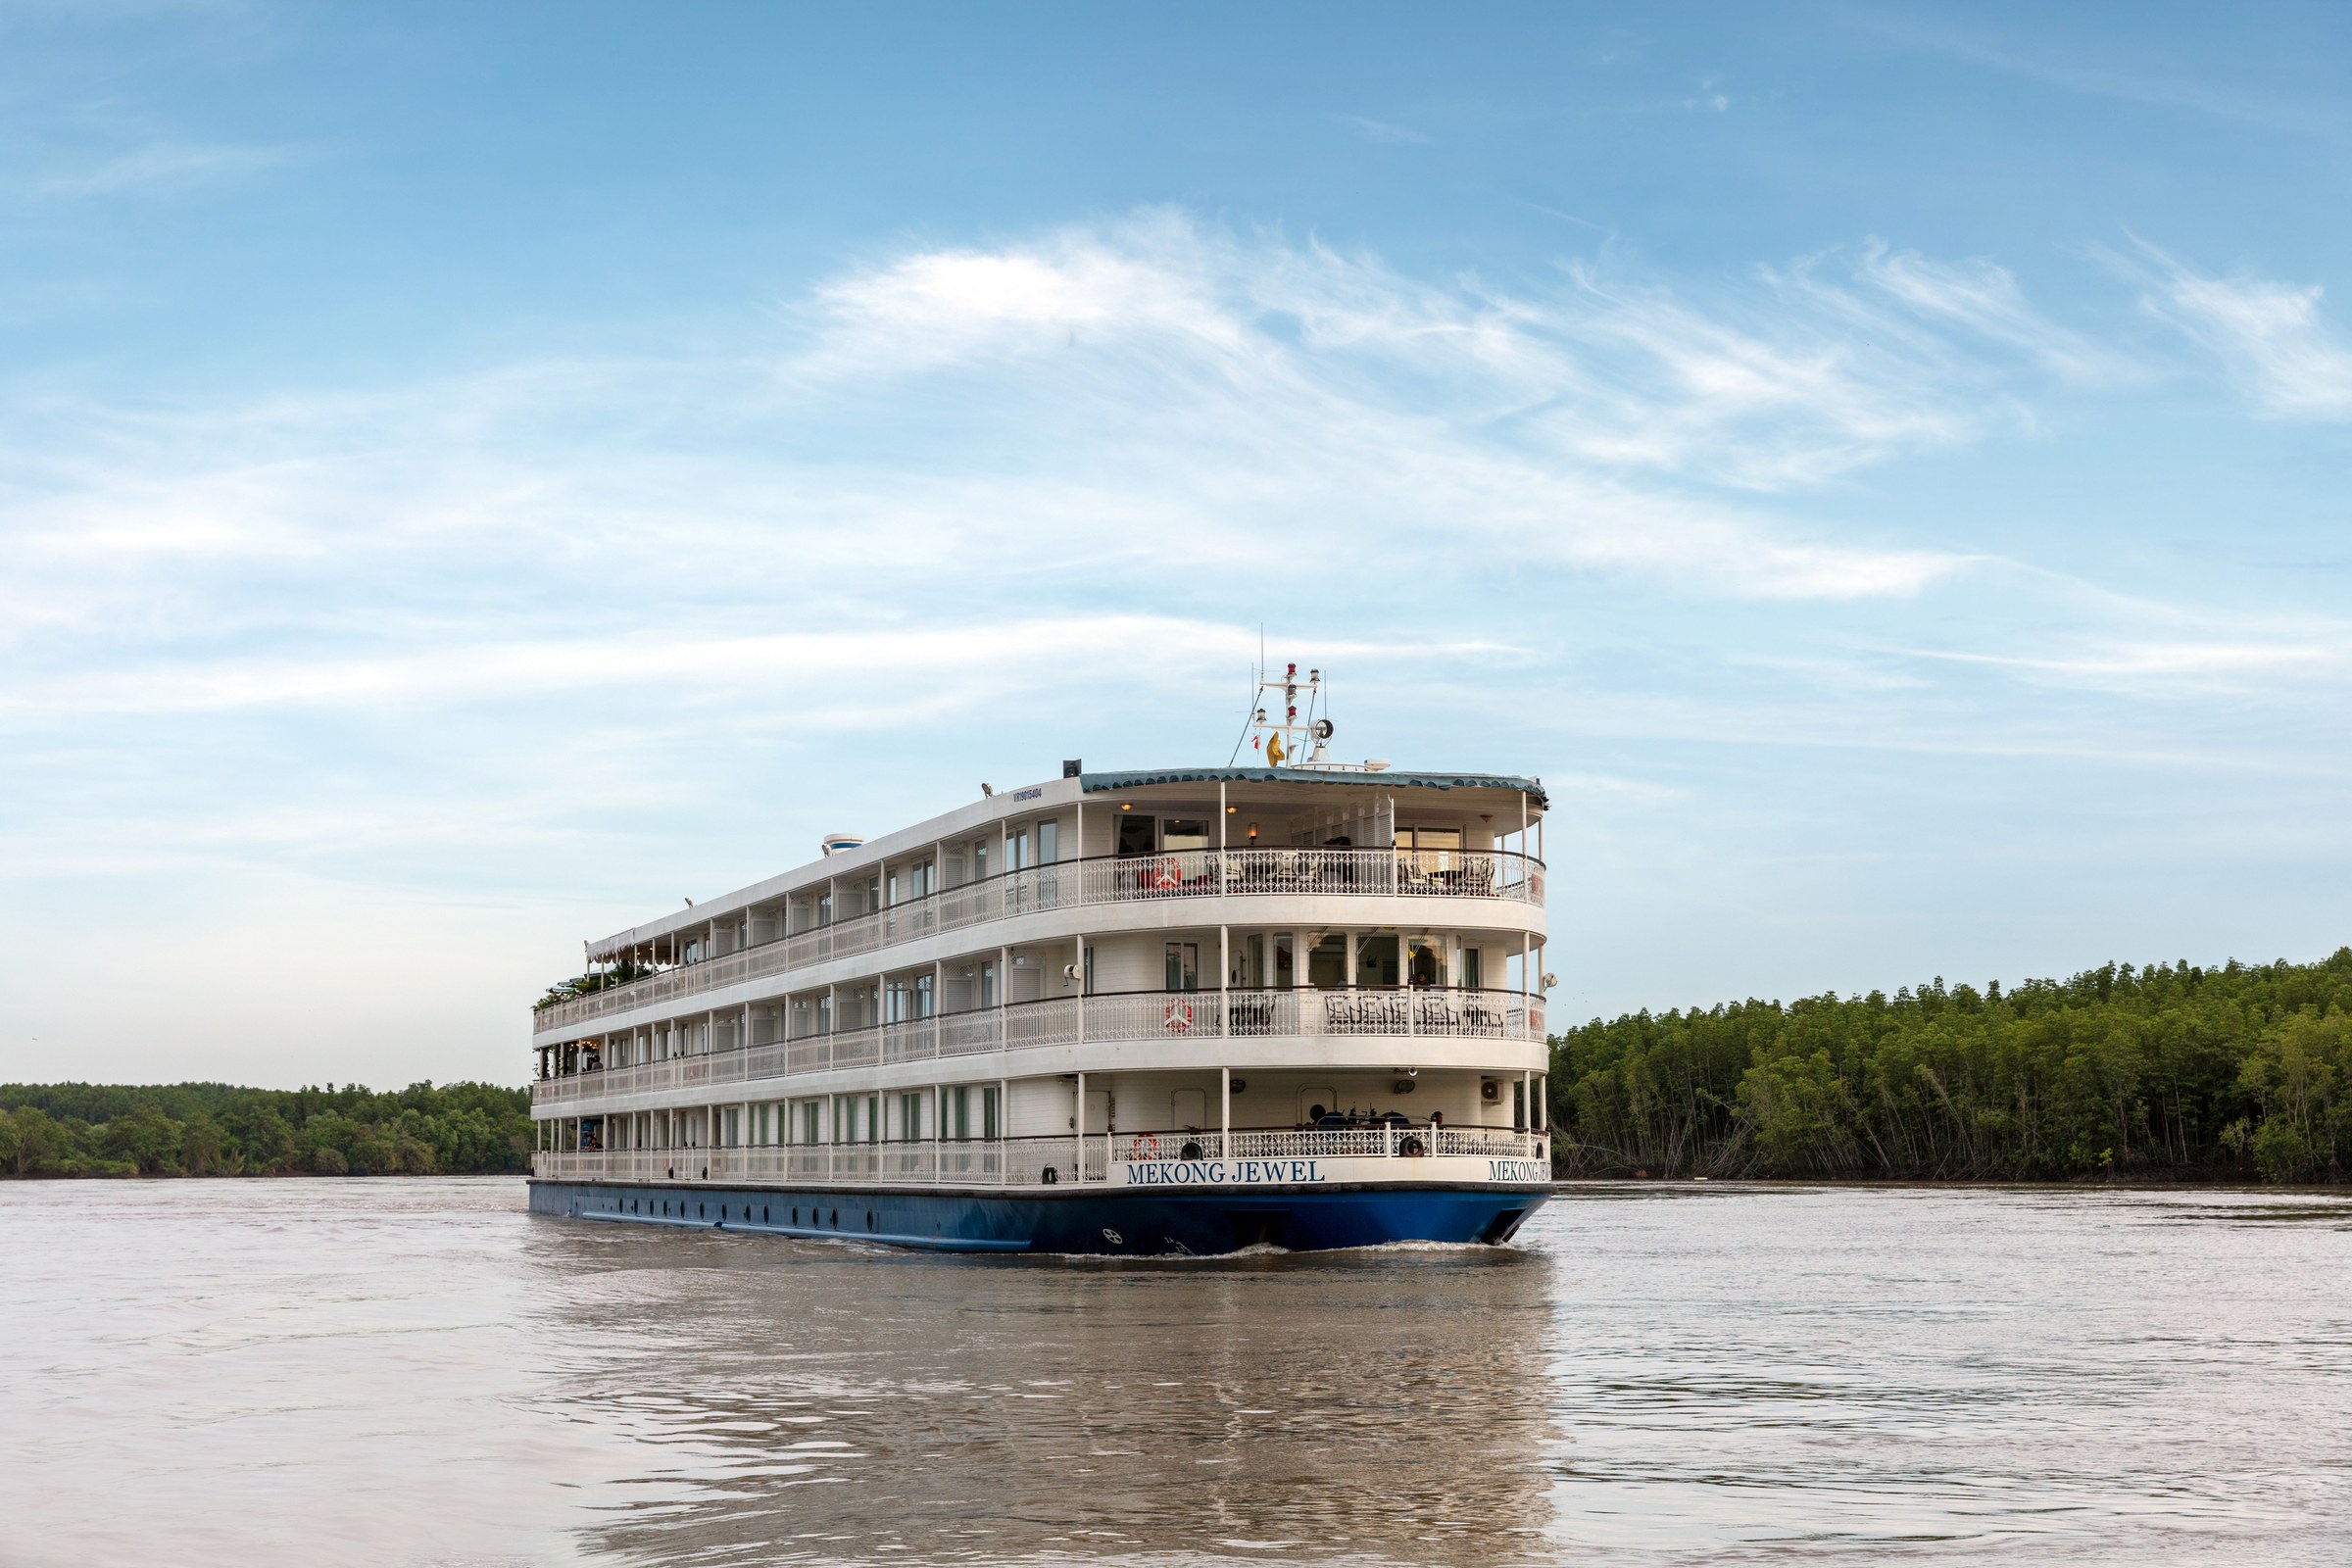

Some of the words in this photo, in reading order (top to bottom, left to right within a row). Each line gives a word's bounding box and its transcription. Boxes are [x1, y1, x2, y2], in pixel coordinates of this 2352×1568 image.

[1127, 1162, 1226, 1185] MEKONG
[1231, 1160, 1326, 1183] JEWEL
[1489, 1160, 1538, 1181] MEKONG
